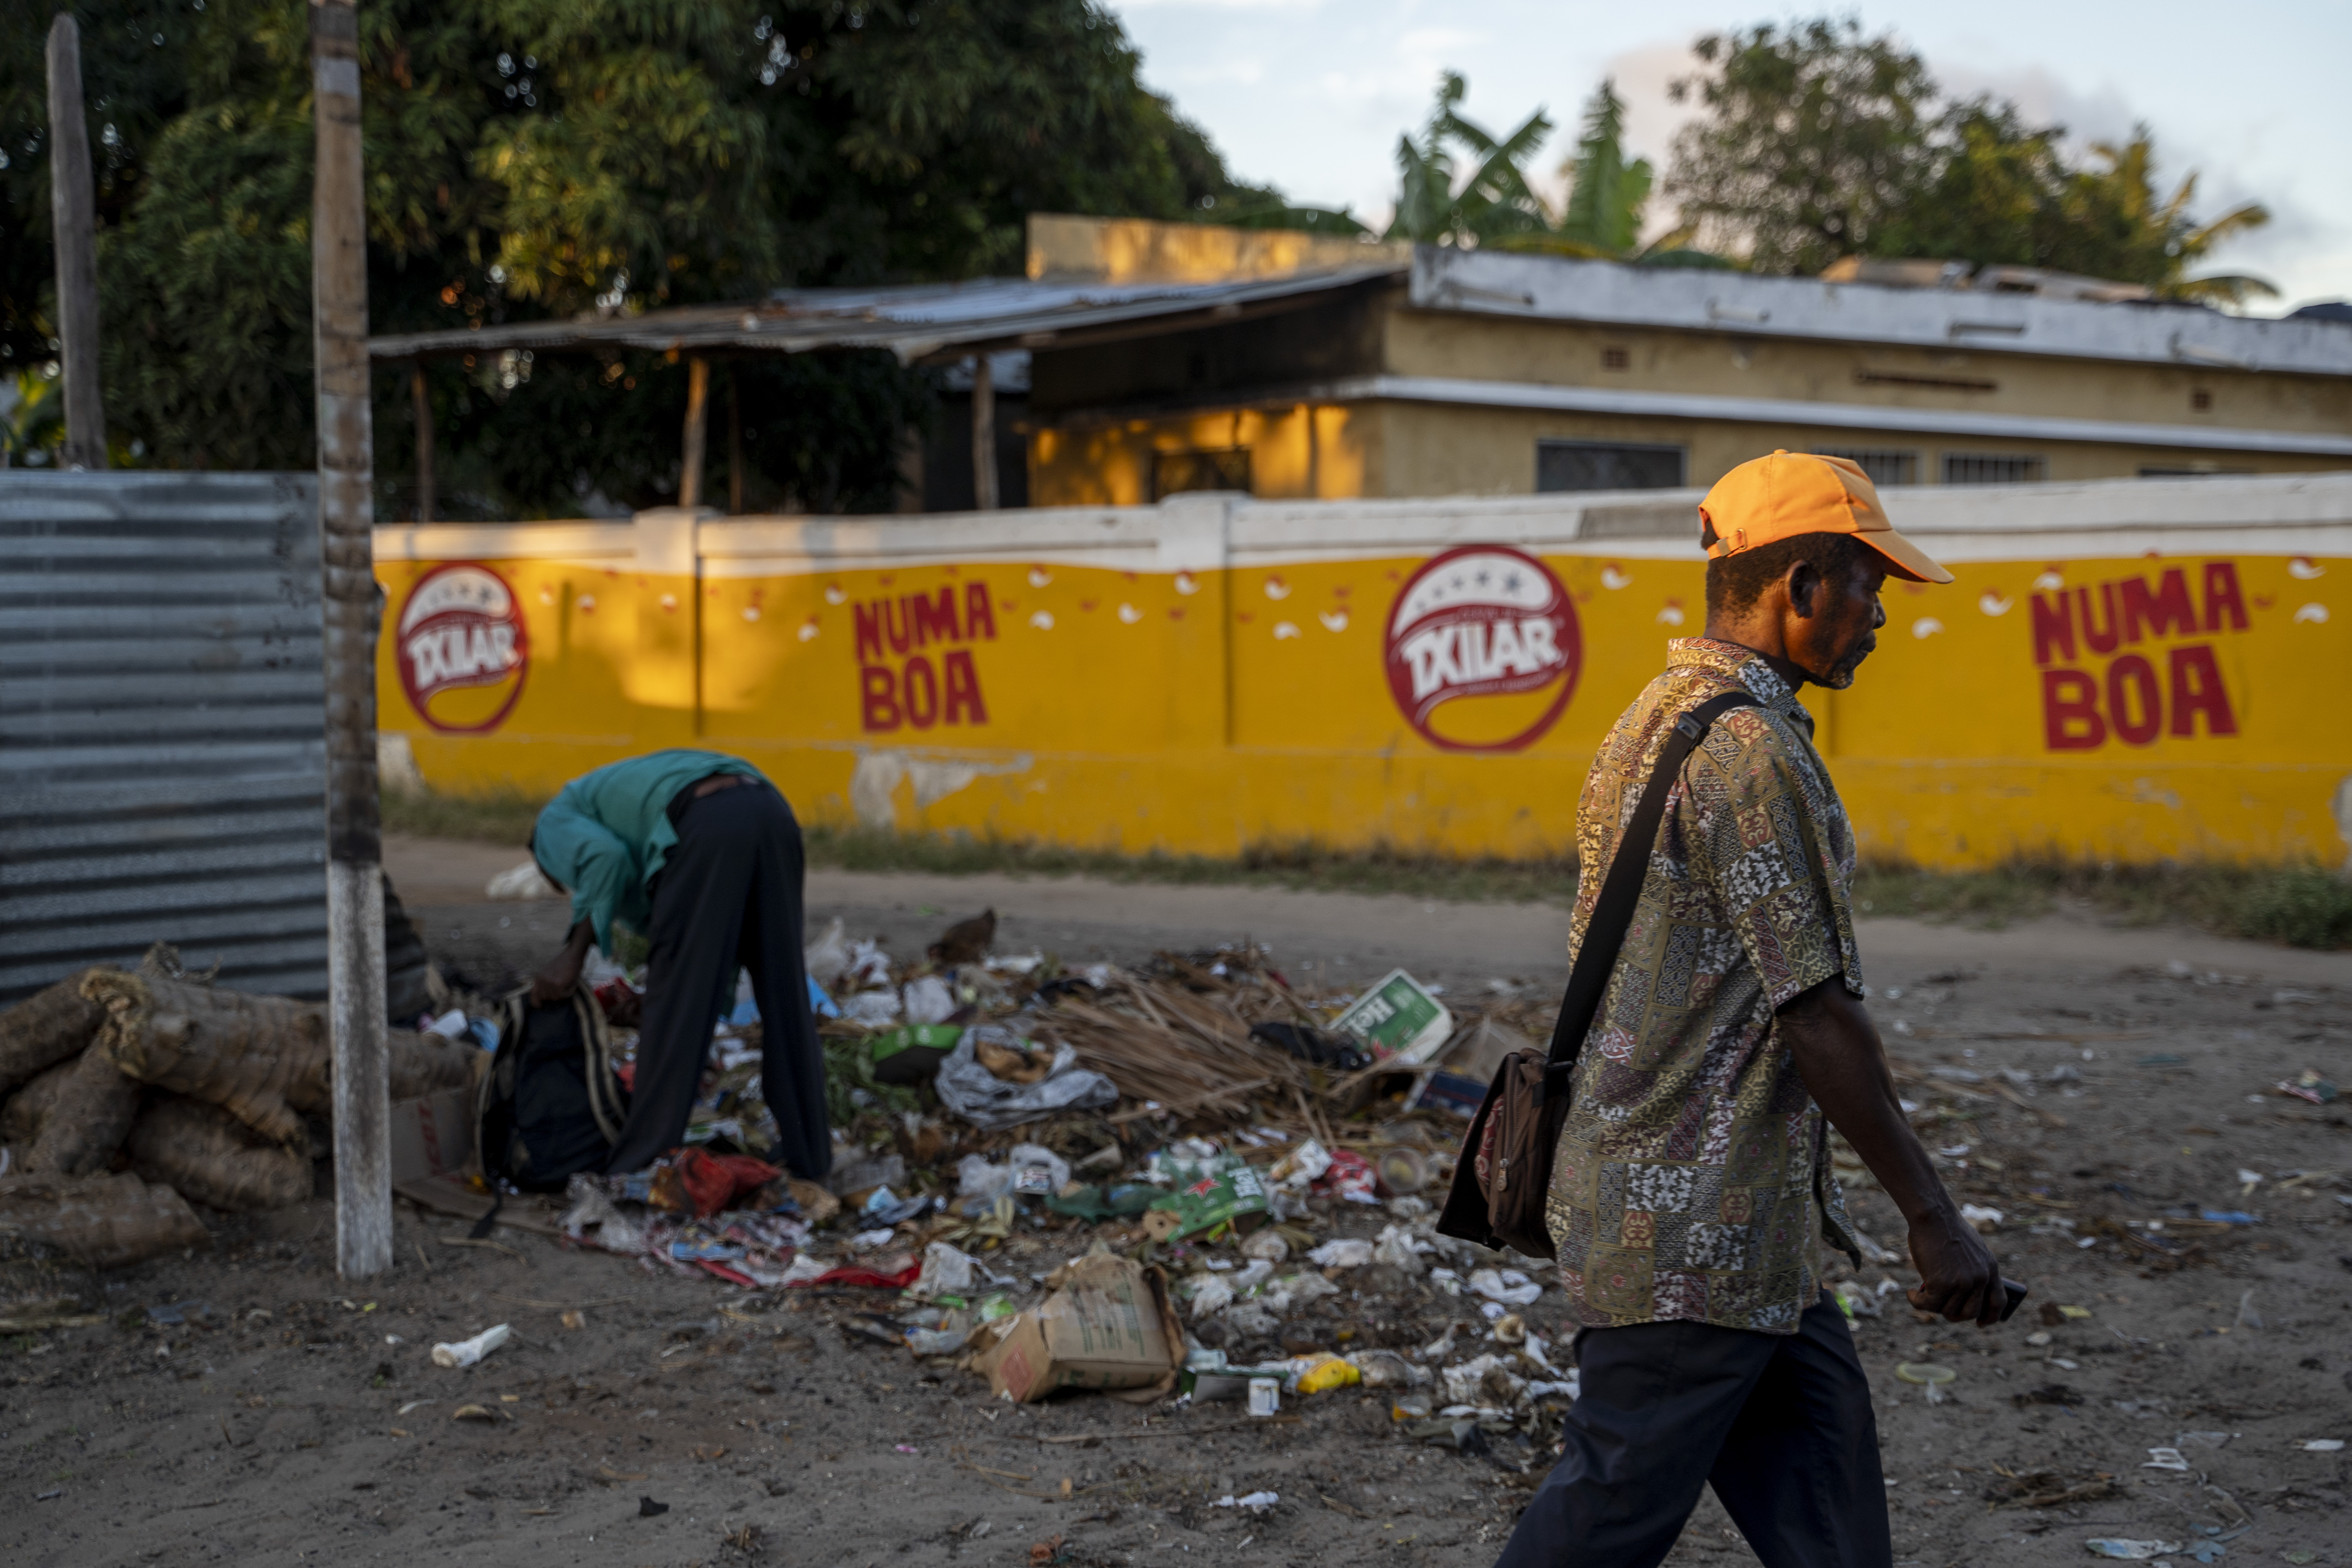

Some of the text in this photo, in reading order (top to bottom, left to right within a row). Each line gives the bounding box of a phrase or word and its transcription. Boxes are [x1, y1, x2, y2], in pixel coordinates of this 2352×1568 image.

[854, 581, 997, 662] NUMA
[2029, 559, 2251, 666] NUMA
[407, 622, 519, 691] TXILAR
[861, 651, 989, 733] BOA
[1400, 617, 1563, 702] TXILAR
[2040, 643, 2239, 753] BOA
